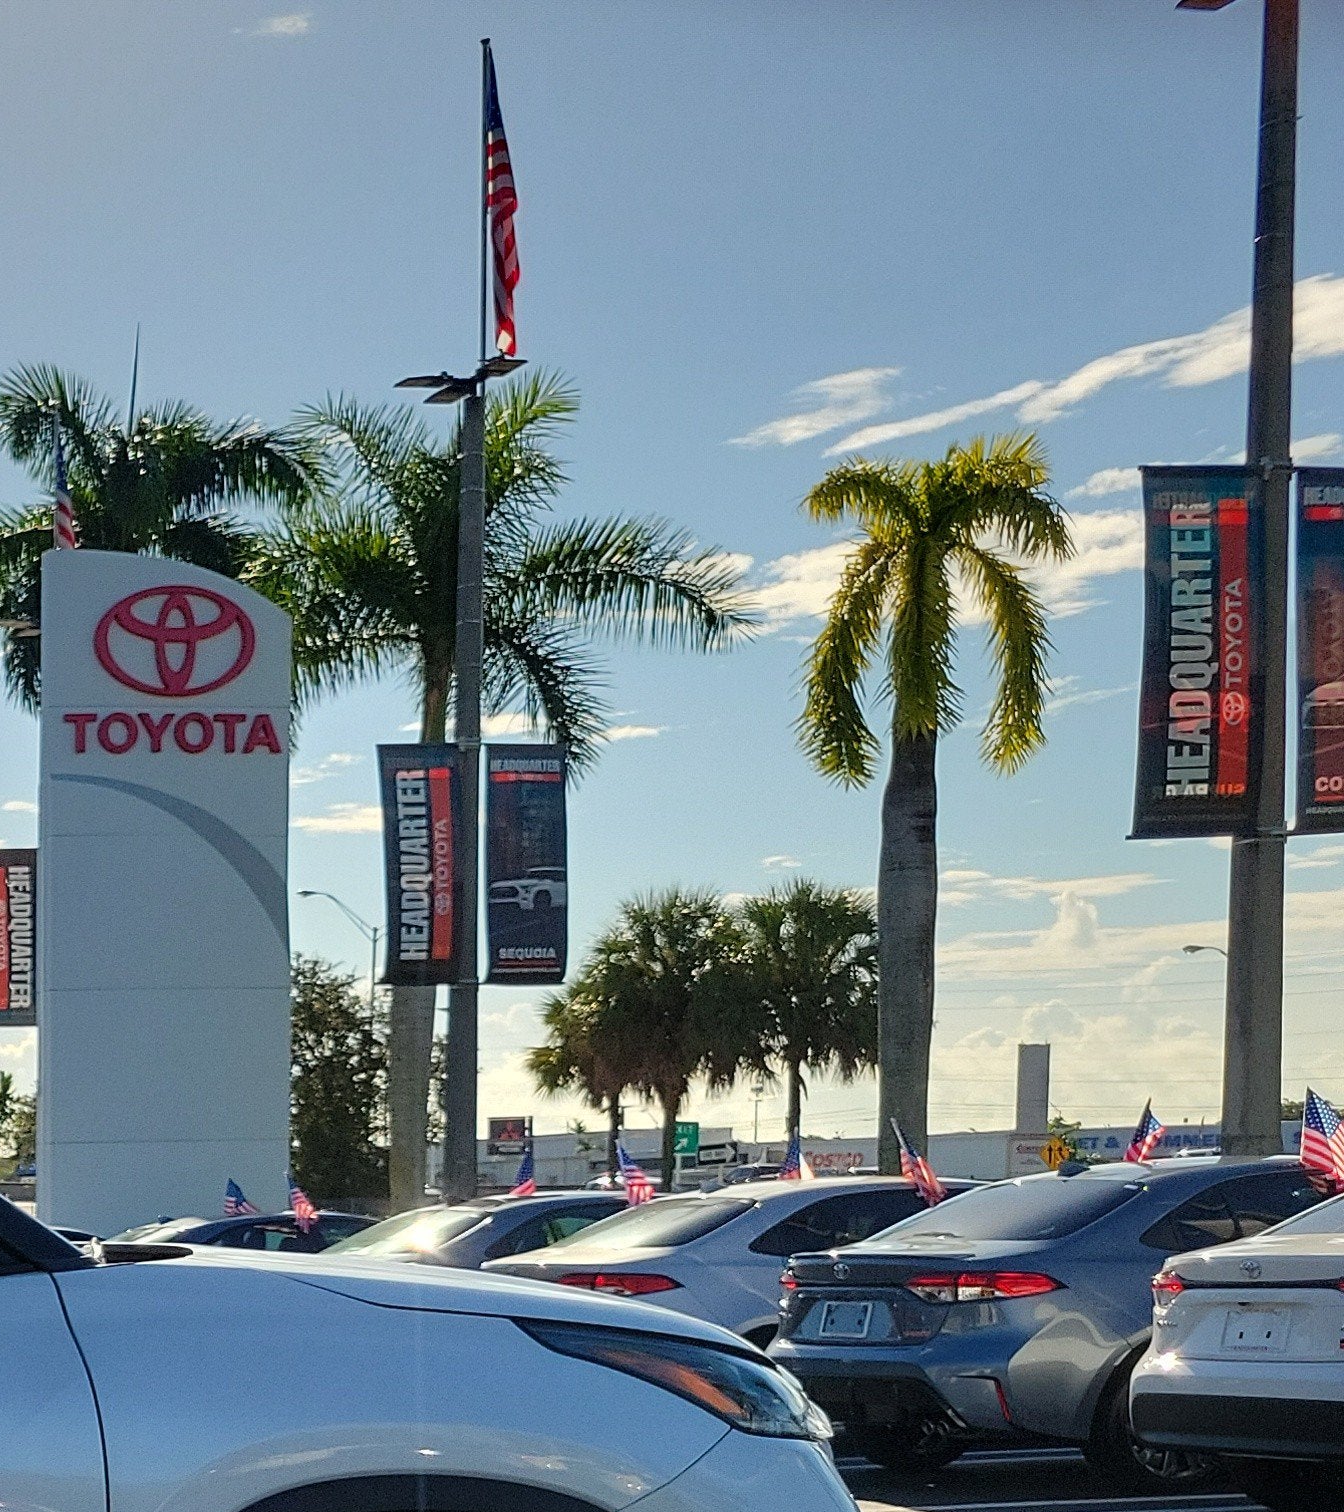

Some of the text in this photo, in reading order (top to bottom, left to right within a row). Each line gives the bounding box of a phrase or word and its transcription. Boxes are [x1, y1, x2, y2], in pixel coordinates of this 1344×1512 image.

[1165, 502, 1219, 796] HEADQUARTER
[1225, 577, 1243, 688] TOYOTA
[63, 712, 282, 755] TOYOTA
[396, 769, 432, 961] HEADQUARTER
[434, 817, 449, 891] TOYOTA
[8, 865, 33, 1009] HEADQUARTER
[499, 946, 557, 960] SEQUOIA
[676, 1124, 694, 1134] XIT
